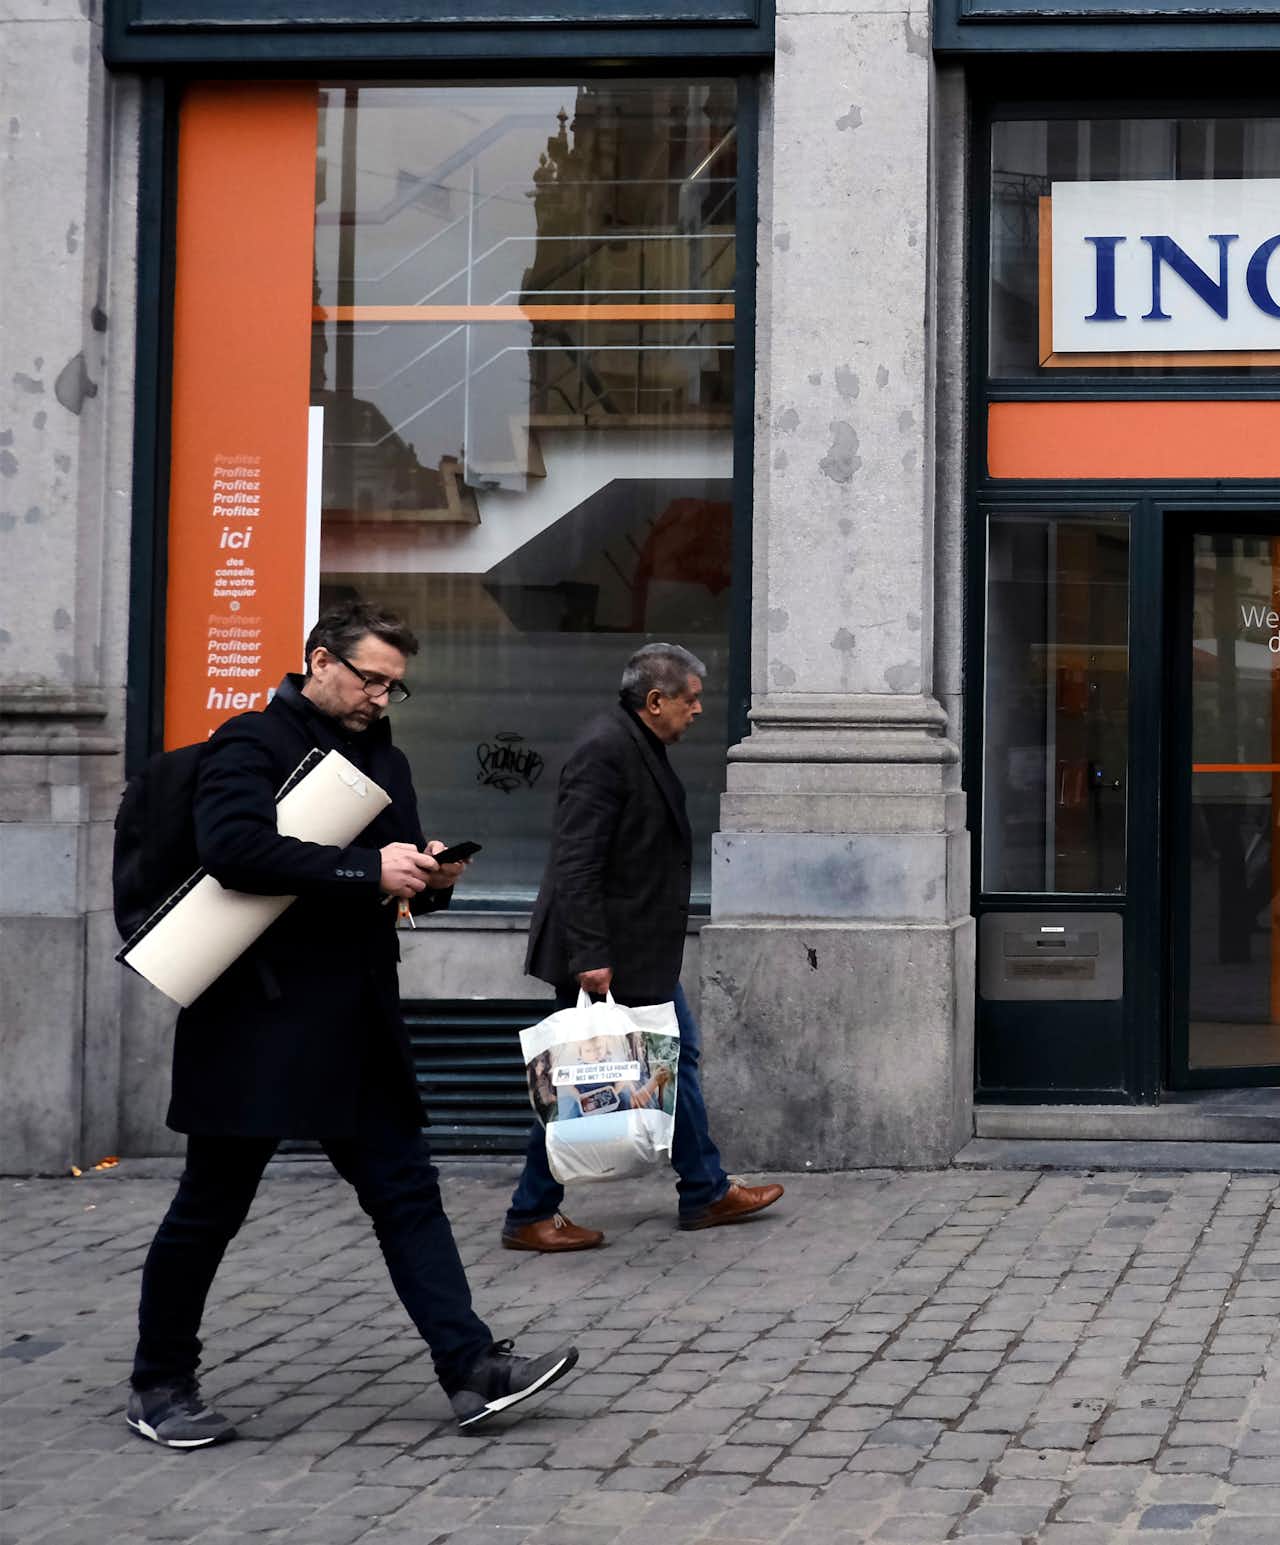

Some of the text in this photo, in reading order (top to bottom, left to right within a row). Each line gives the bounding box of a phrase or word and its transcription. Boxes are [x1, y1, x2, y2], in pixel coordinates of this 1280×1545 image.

[214, 467, 261, 478] Profitez
[213, 480, 261, 491] Profitez
[213, 493, 261, 504] Profitez
[213, 505, 261, 517] Profitez
[220, 526, 253, 549] ici
[226, 558, 244, 567] des
[215, 568, 255, 577] conseils
[215, 578, 255, 587] de votre
[213, 588, 257, 598] banquier
[207, 627, 262, 638] Profiteer
[207, 640, 262, 651] Profiteer
[207, 653, 262, 665] Profiteer
[207, 667, 262, 678] Profiteer
[206, 687, 262, 710] hier
